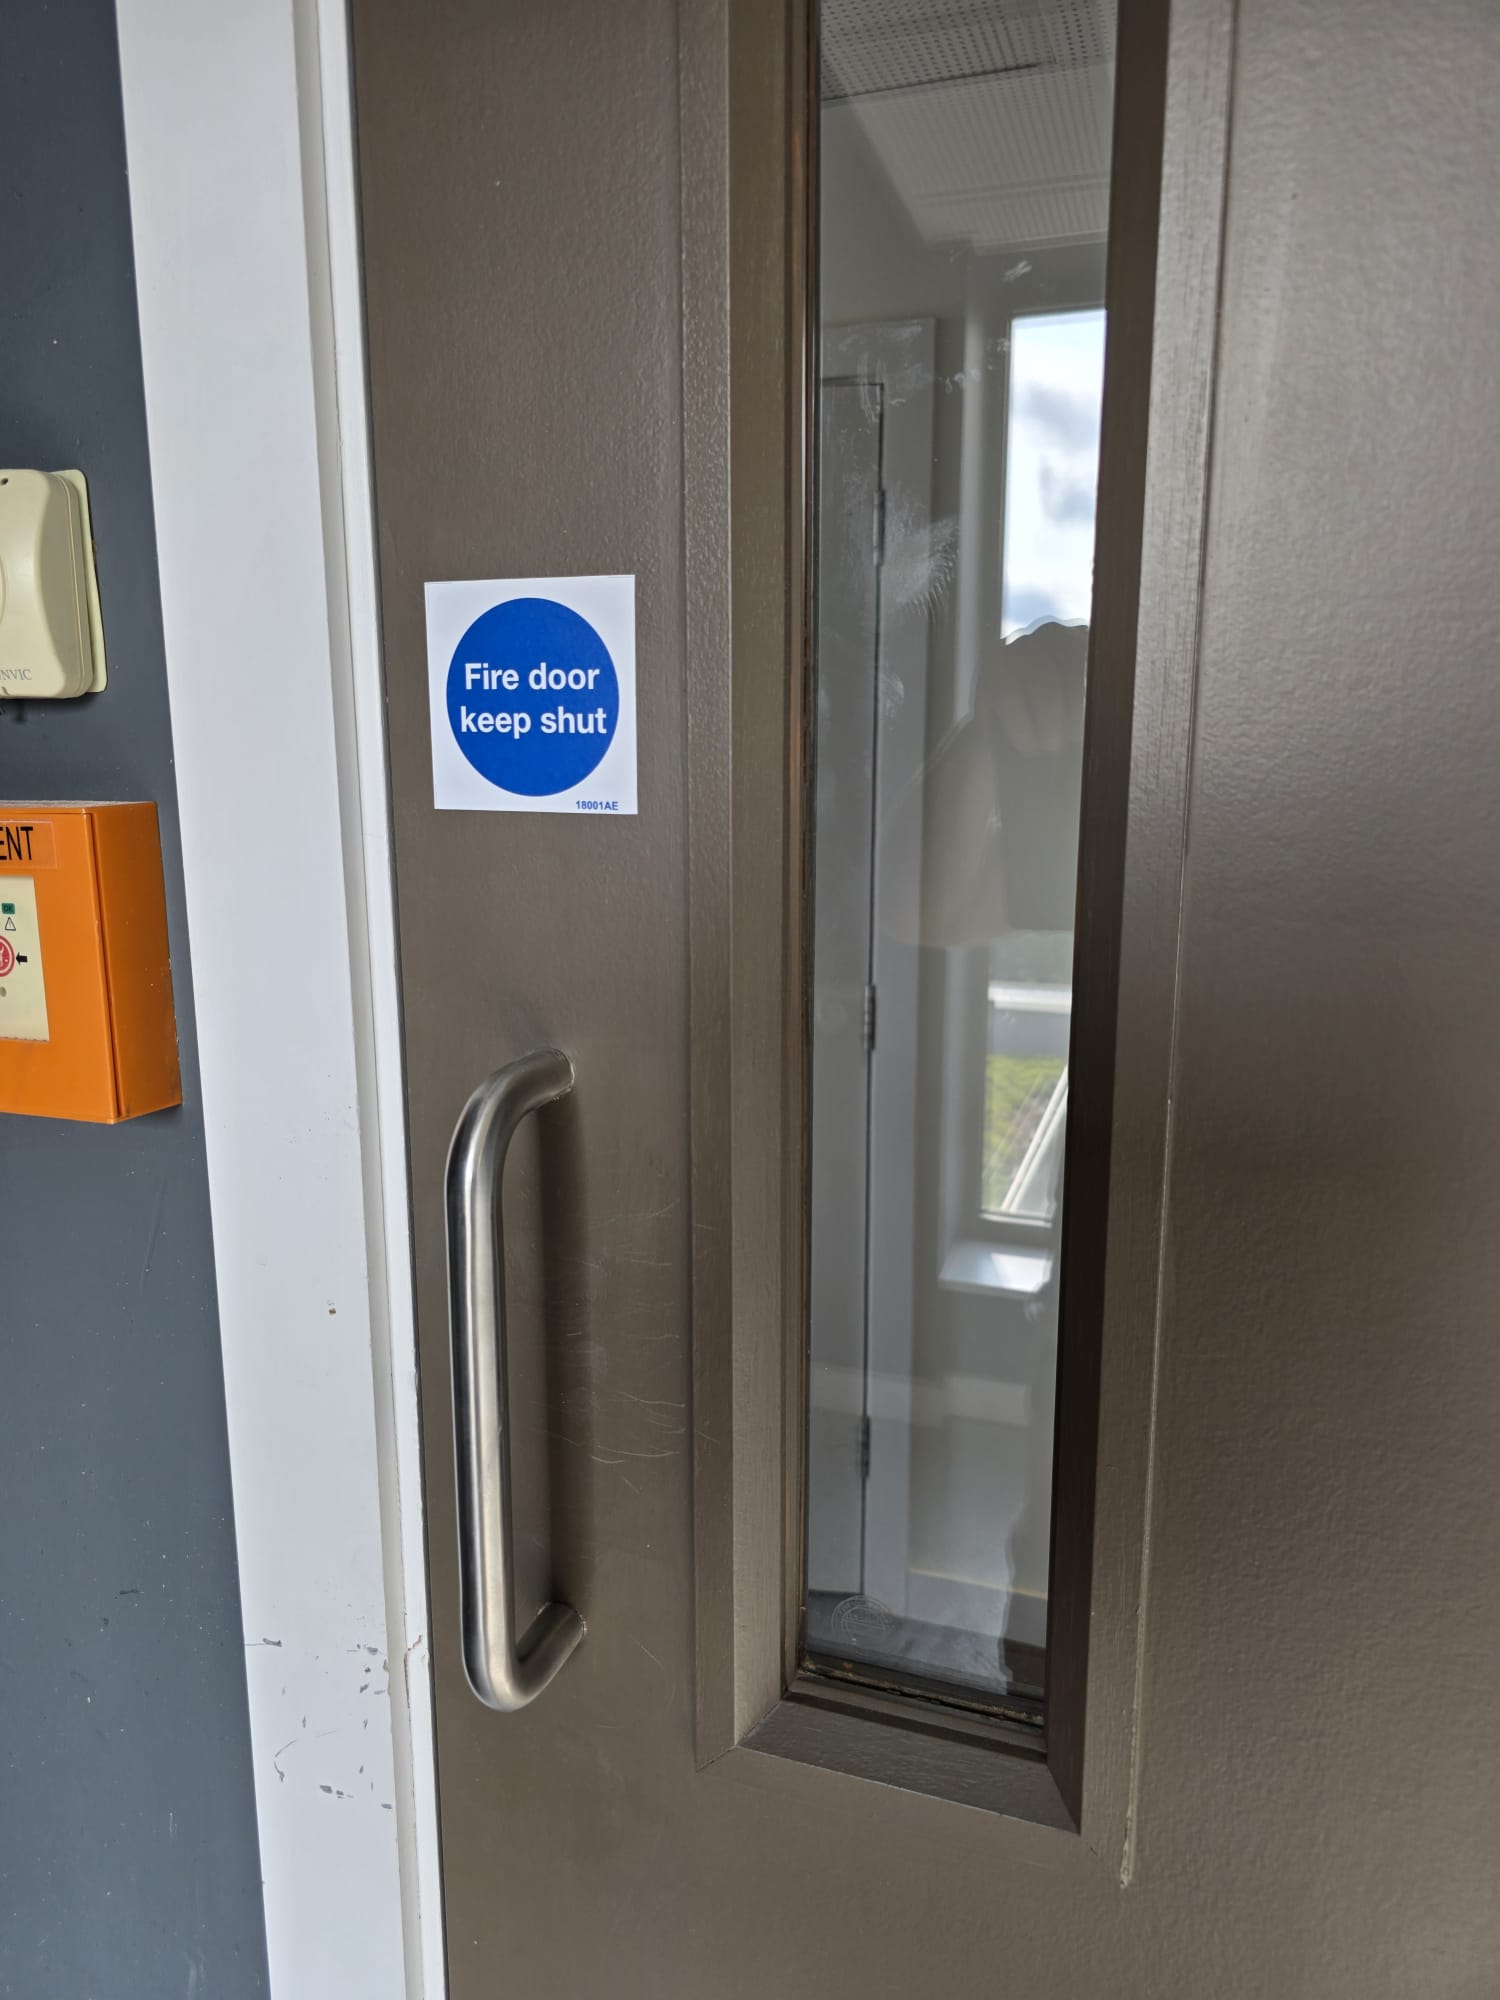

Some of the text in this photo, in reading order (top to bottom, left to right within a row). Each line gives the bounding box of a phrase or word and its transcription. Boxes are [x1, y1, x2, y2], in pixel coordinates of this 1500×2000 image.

[465, 661, 600, 690] Fire door
[460, 705, 608, 740] keep shut
[575, 800, 619, 811] 18001AE
